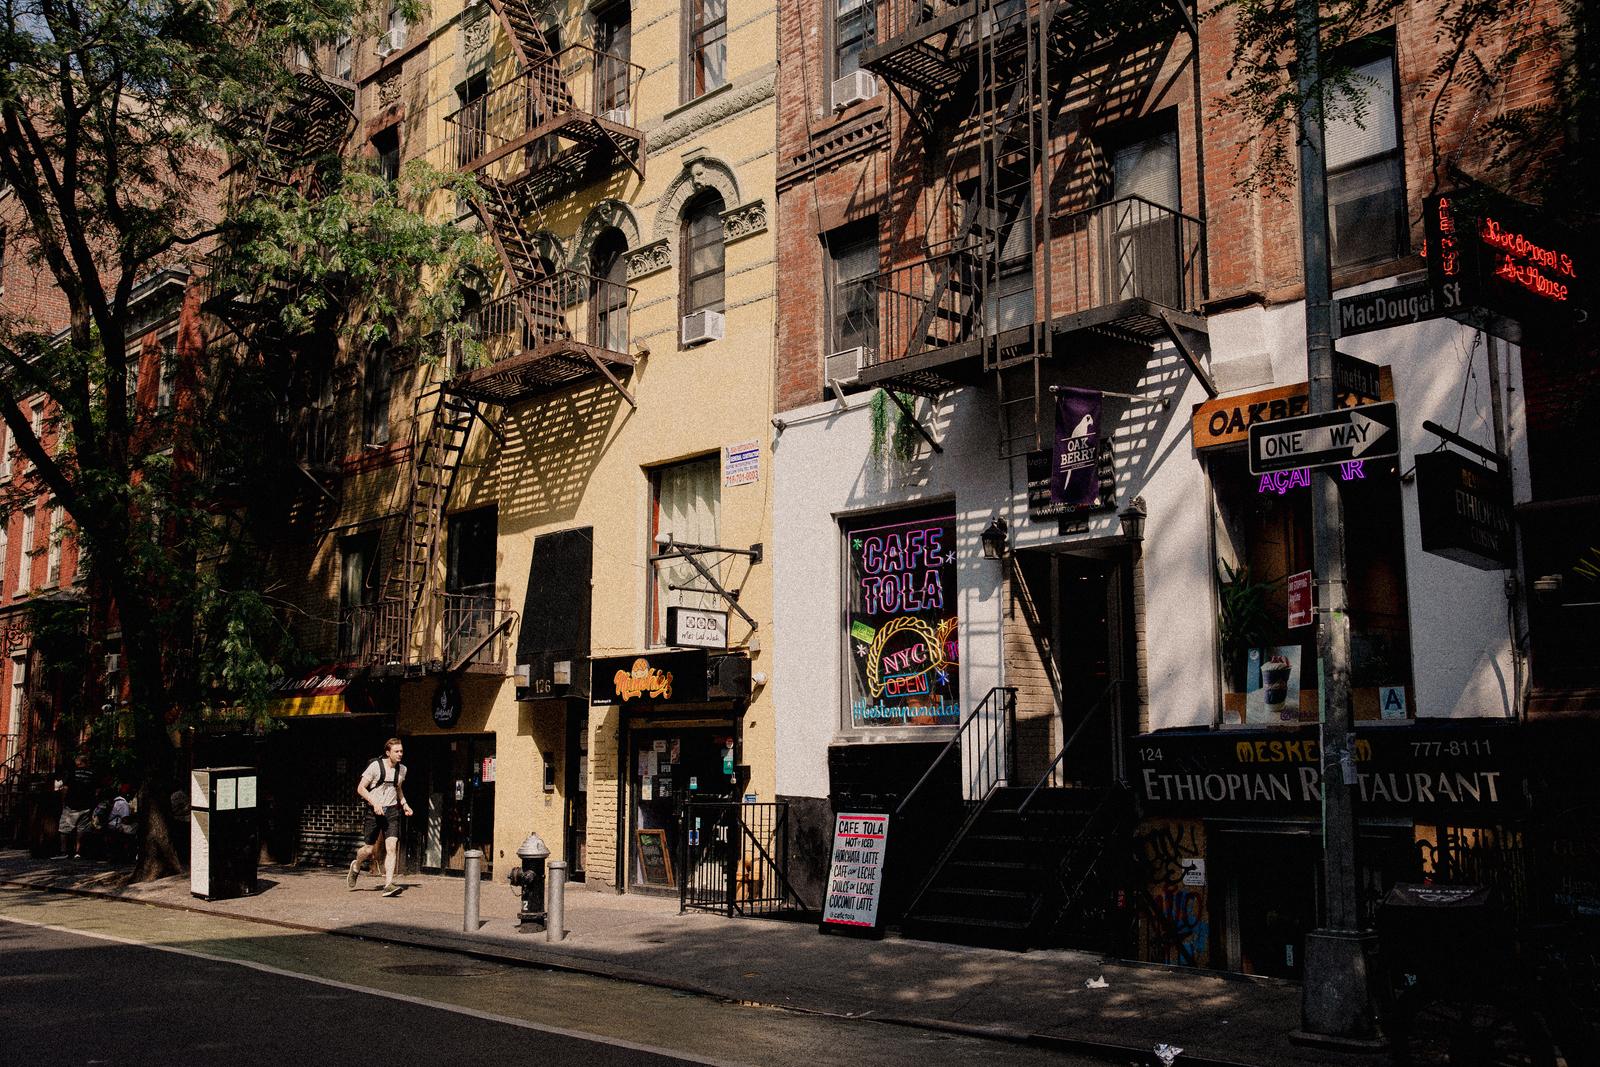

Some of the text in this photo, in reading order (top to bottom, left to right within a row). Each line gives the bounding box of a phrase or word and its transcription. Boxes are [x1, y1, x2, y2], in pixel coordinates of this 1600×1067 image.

[1342, 290, 1434, 329] MacDougal
[1443, 282, 1461, 308] St
[1067, 437, 1089, 452] OAK
[1266, 422, 1371, 457] ONE WAY
[1061, 447, 1096, 466] BERRY
[862, 527, 944, 574] CAFE
[862, 569, 943, 615] TOLA
[882, 643, 927, 675] NYC
[535, 680, 551, 694] 126
[886, 674, 927, 695] OPEN
[1384, 689, 1402, 710] A
[1141, 748, 1163, 761] 124
[1236, 740, 1372, 763] MESKEM
[1411, 740, 1491, 757] 777-8111
[1298, 766, 1500, 803] RTAURANT
[838, 821, 884, 835] CAFE TOLA
[845, 838, 857, 847] HOT
[861, 839, 874, 848] ICED
[861, 852, 880, 865] LATTE
[833, 865, 848, 878] CAFE
[857, 867, 876, 880] LECHE
[832, 880, 850, 892] DULCE
[856, 883, 875, 896] LECHE
[523, 900, 529, 911] 2
[829, 895, 873, 911] COCONUT LATTE
